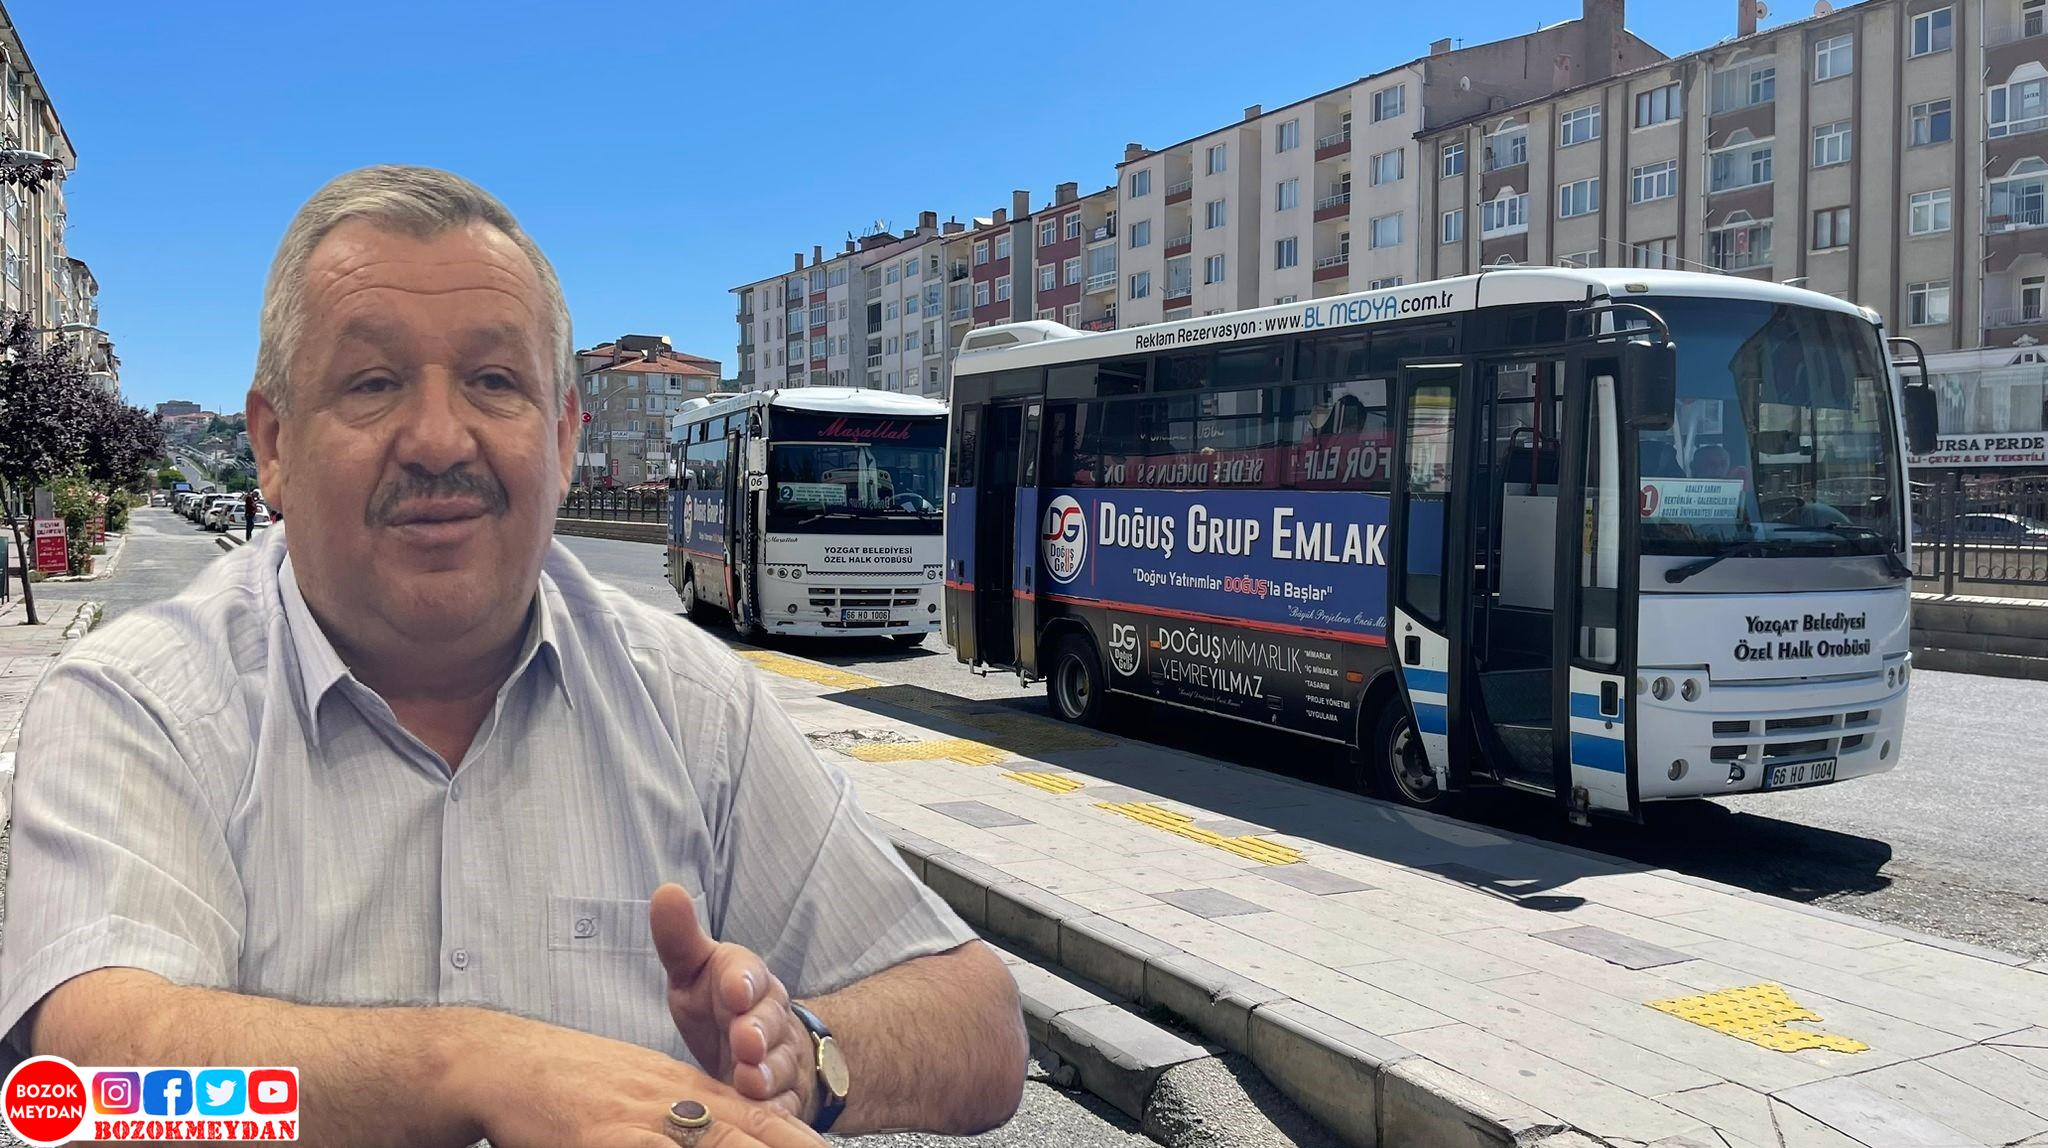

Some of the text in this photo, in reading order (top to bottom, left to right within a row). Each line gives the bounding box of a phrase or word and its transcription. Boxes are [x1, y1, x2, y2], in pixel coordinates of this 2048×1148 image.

[1135, 332, 1175, 350] Reklam
[1177, 321, 1256, 343] Rezervasyon
[1936, 437, 2044, 451] URSA PERDE
[1974, 455, 1989, 463] EV
[1994, 452, 2045, 462] TEKSTİLİ
[751, 478, 762, 486] 06
[1642, 490, 1653, 511] 1
[1100, 502, 1388, 566] DOĞUŞ GRUP EMLAK
[824, 546, 913, 555] YOZGAT BELEDİYESİ
[824, 556, 913, 564] ÖZEL HALK OTOBÜSÜ
[1169, 571, 1222, 591] Yatırımlar
[1773, 768, 1787, 785] 66
[1810, 761, 1833, 780] 1004
